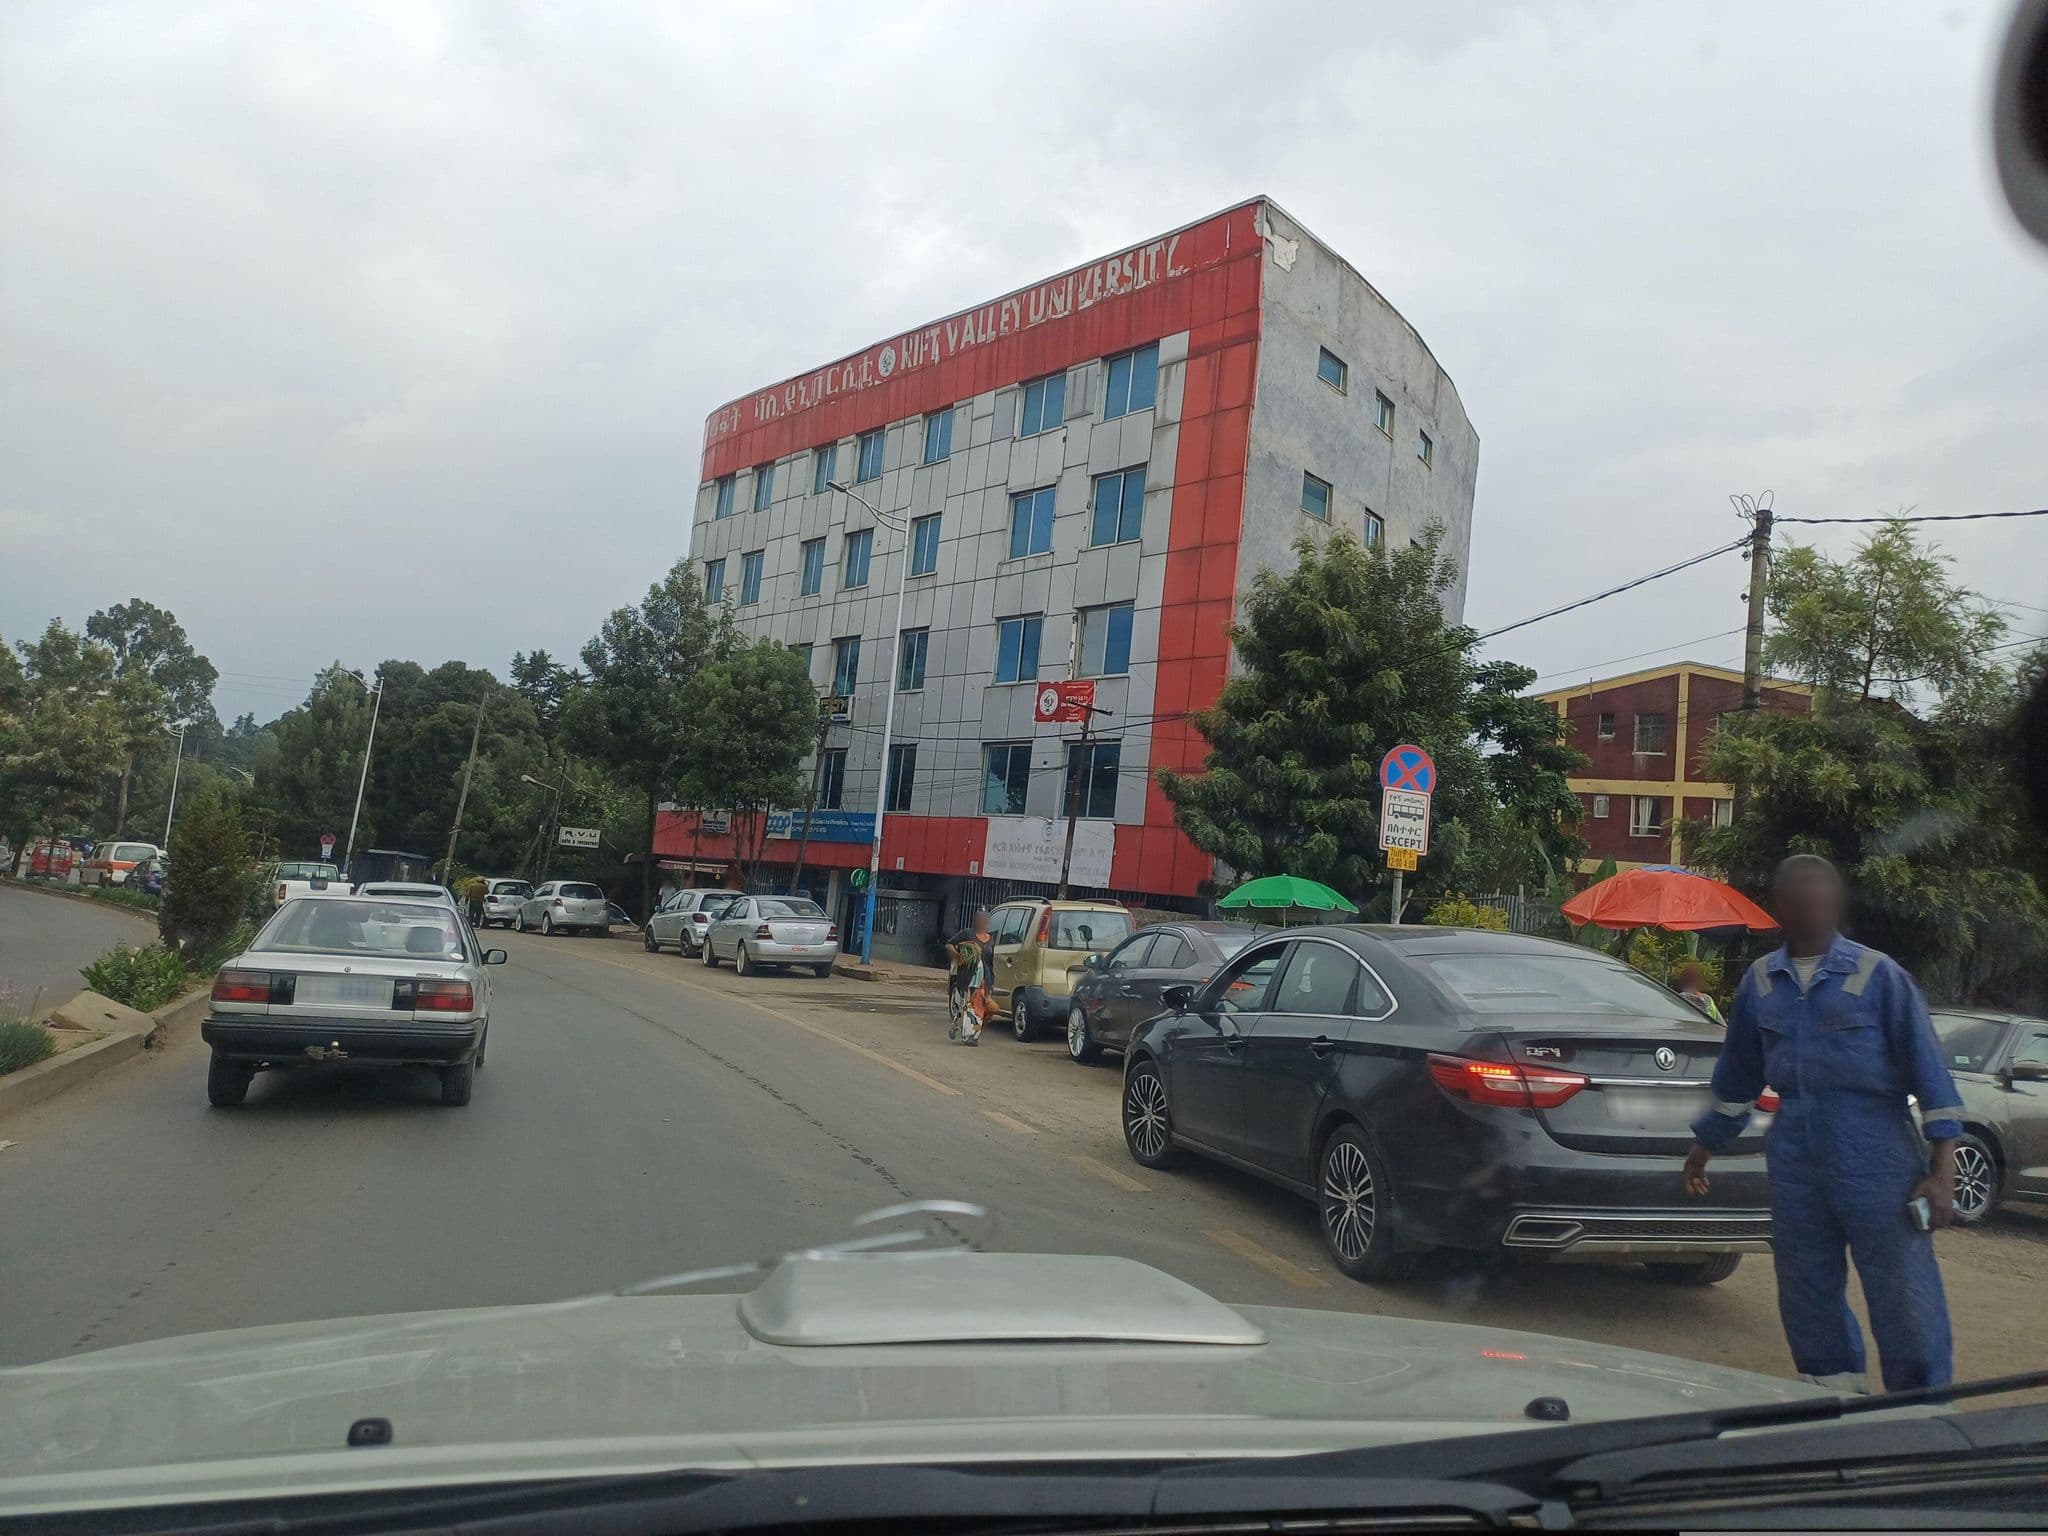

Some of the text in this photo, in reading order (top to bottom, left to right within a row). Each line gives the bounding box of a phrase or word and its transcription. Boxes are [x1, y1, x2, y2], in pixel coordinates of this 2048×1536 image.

[901, 235, 1181, 369] RIFT VALLEY UNIVERSITY
[1385, 835, 1422, 849] EXCEPT
